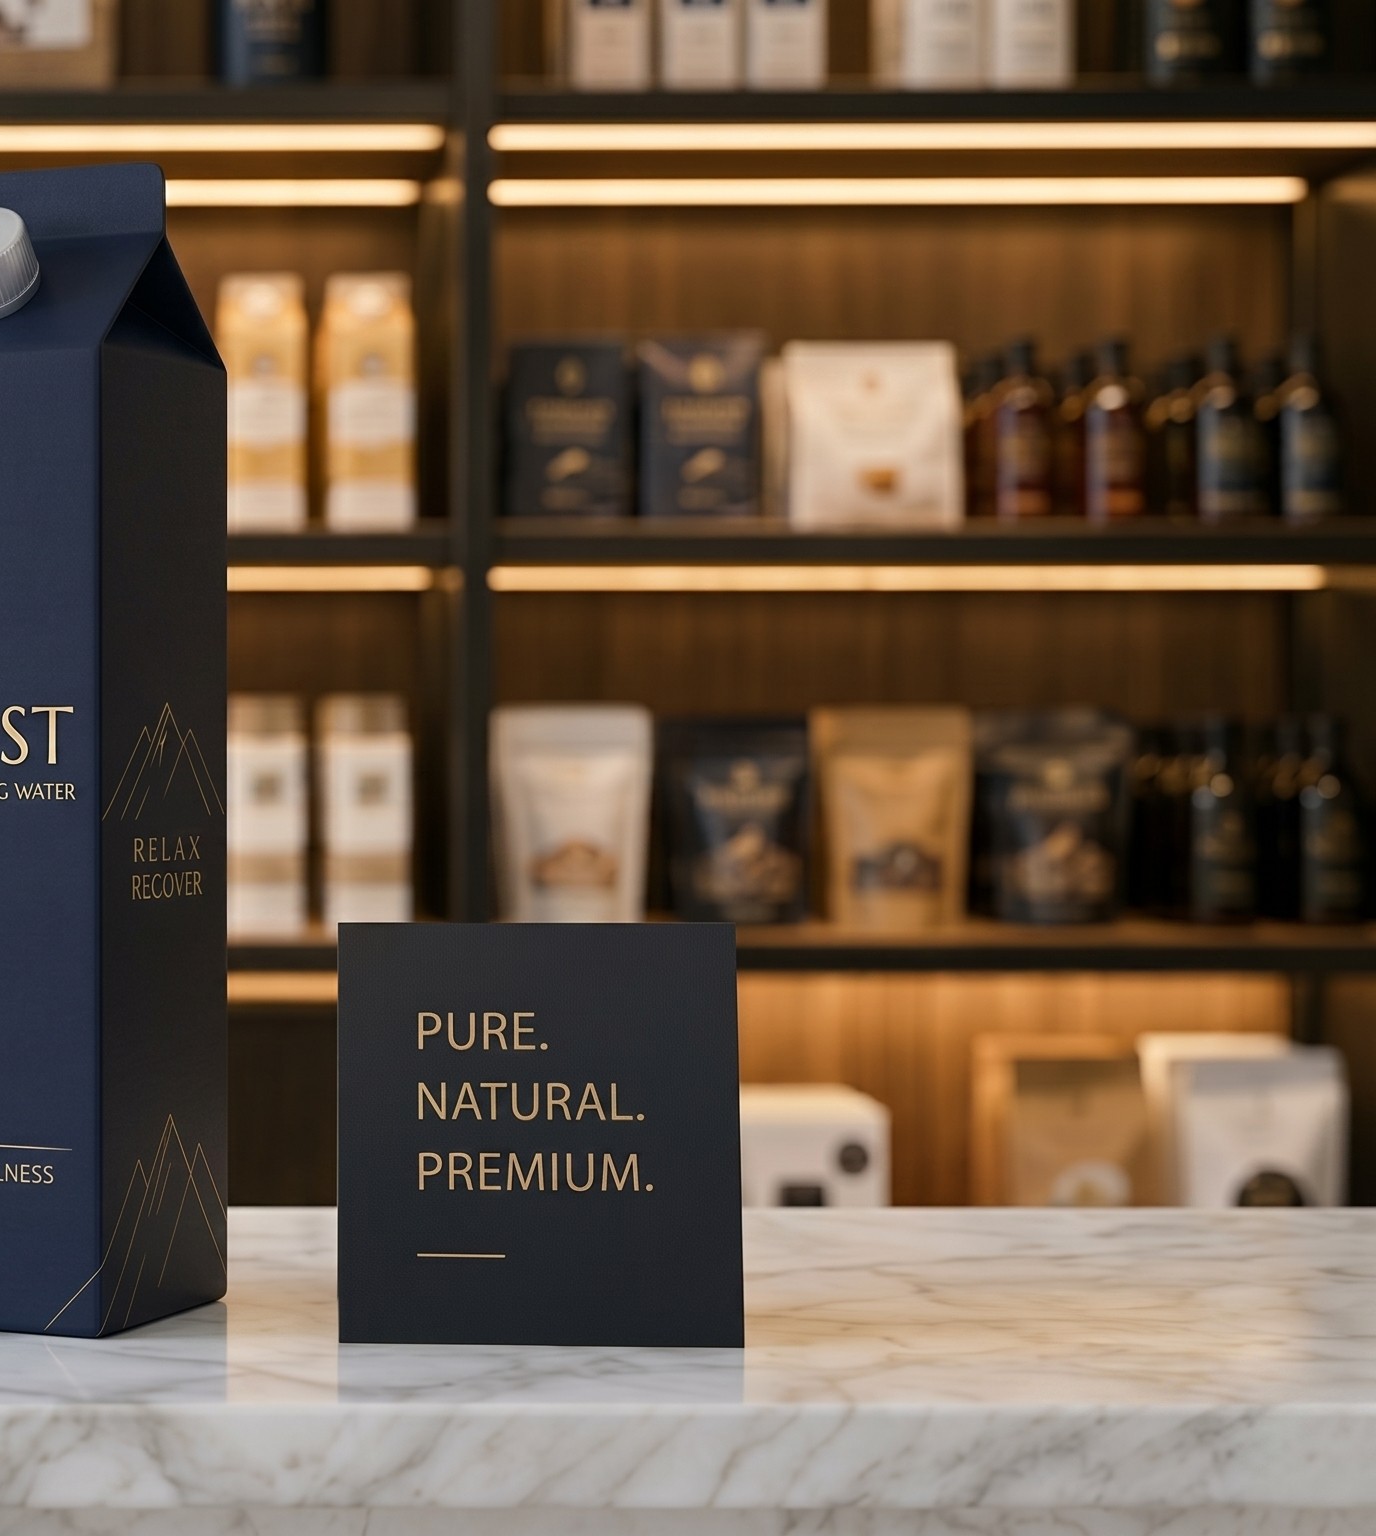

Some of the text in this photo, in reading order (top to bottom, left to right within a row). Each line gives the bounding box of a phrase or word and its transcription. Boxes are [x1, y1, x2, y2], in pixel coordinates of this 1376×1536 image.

[14, 782, 76, 801] WATER
[133, 835, 201, 863] RELAX
[131, 870, 203, 900] RECOVER
[416, 1010, 549, 1052] PURE.
[416, 1080, 645, 1123] NATURAL.
[417, 1150, 654, 1193] PREMIUM.
